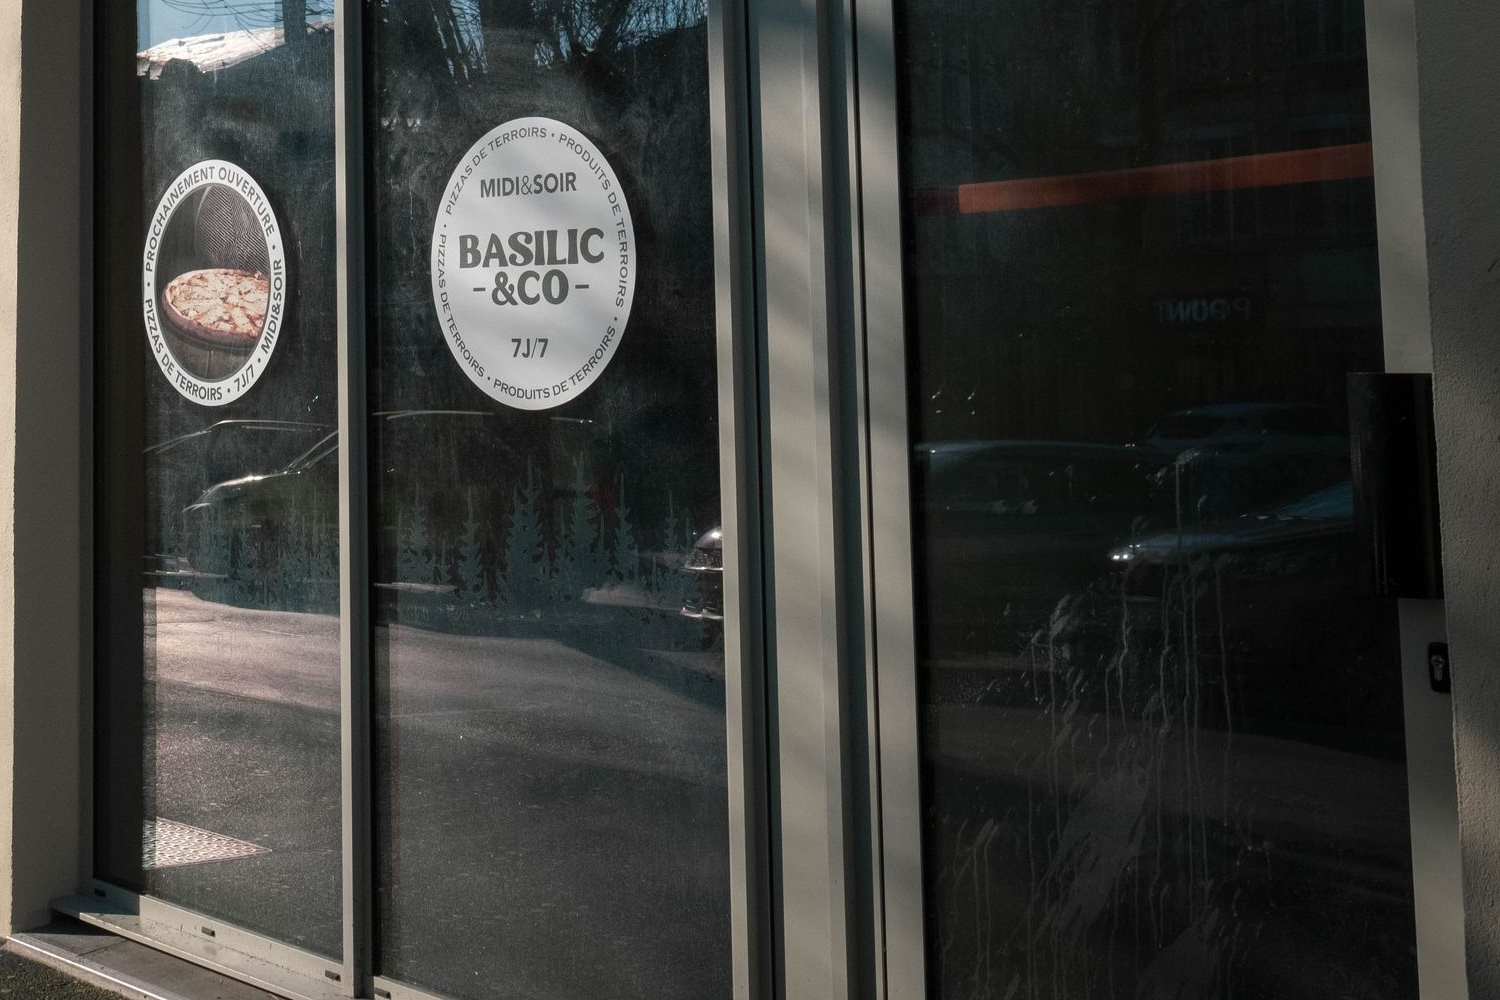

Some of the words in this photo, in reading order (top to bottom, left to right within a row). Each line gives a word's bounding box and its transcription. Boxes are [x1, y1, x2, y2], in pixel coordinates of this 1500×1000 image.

[445, 165, 473, 216] PIZZAS
[472, 148, 488, 167] DE
[487, 126, 547, 153] TERROIRS
[480, 171, 577, 199] MIDI&SOIR
[146, 166, 216, 272] PROCHAINEMENT
[218, 166, 276, 237] OUVERTURE
[459, 227, 605, 270] BASILIC
[559, 133, 611, 190] PRODUITS
[607, 193, 621, 216] DE
[615, 218, 629, 309] TERROIRS
[437, 233, 447, 289] PIZZAS
[261, 259, 282, 355] MIDI&SOIR
[440, 290, 451, 313] DE
[145, 298, 164, 355] PIZZAS
[161, 354, 174, 377] DE
[174, 371, 223, 402] TERROIRS
[446, 316, 485, 379] TERROIRS
[493, 378, 551, 401] PRODUITS
[552, 380, 569, 397] DE
[569, 325, 616, 391] TERROIRS
[511, 337, 549, 359] 7J/7
[234, 366, 255, 394] 7J/7
